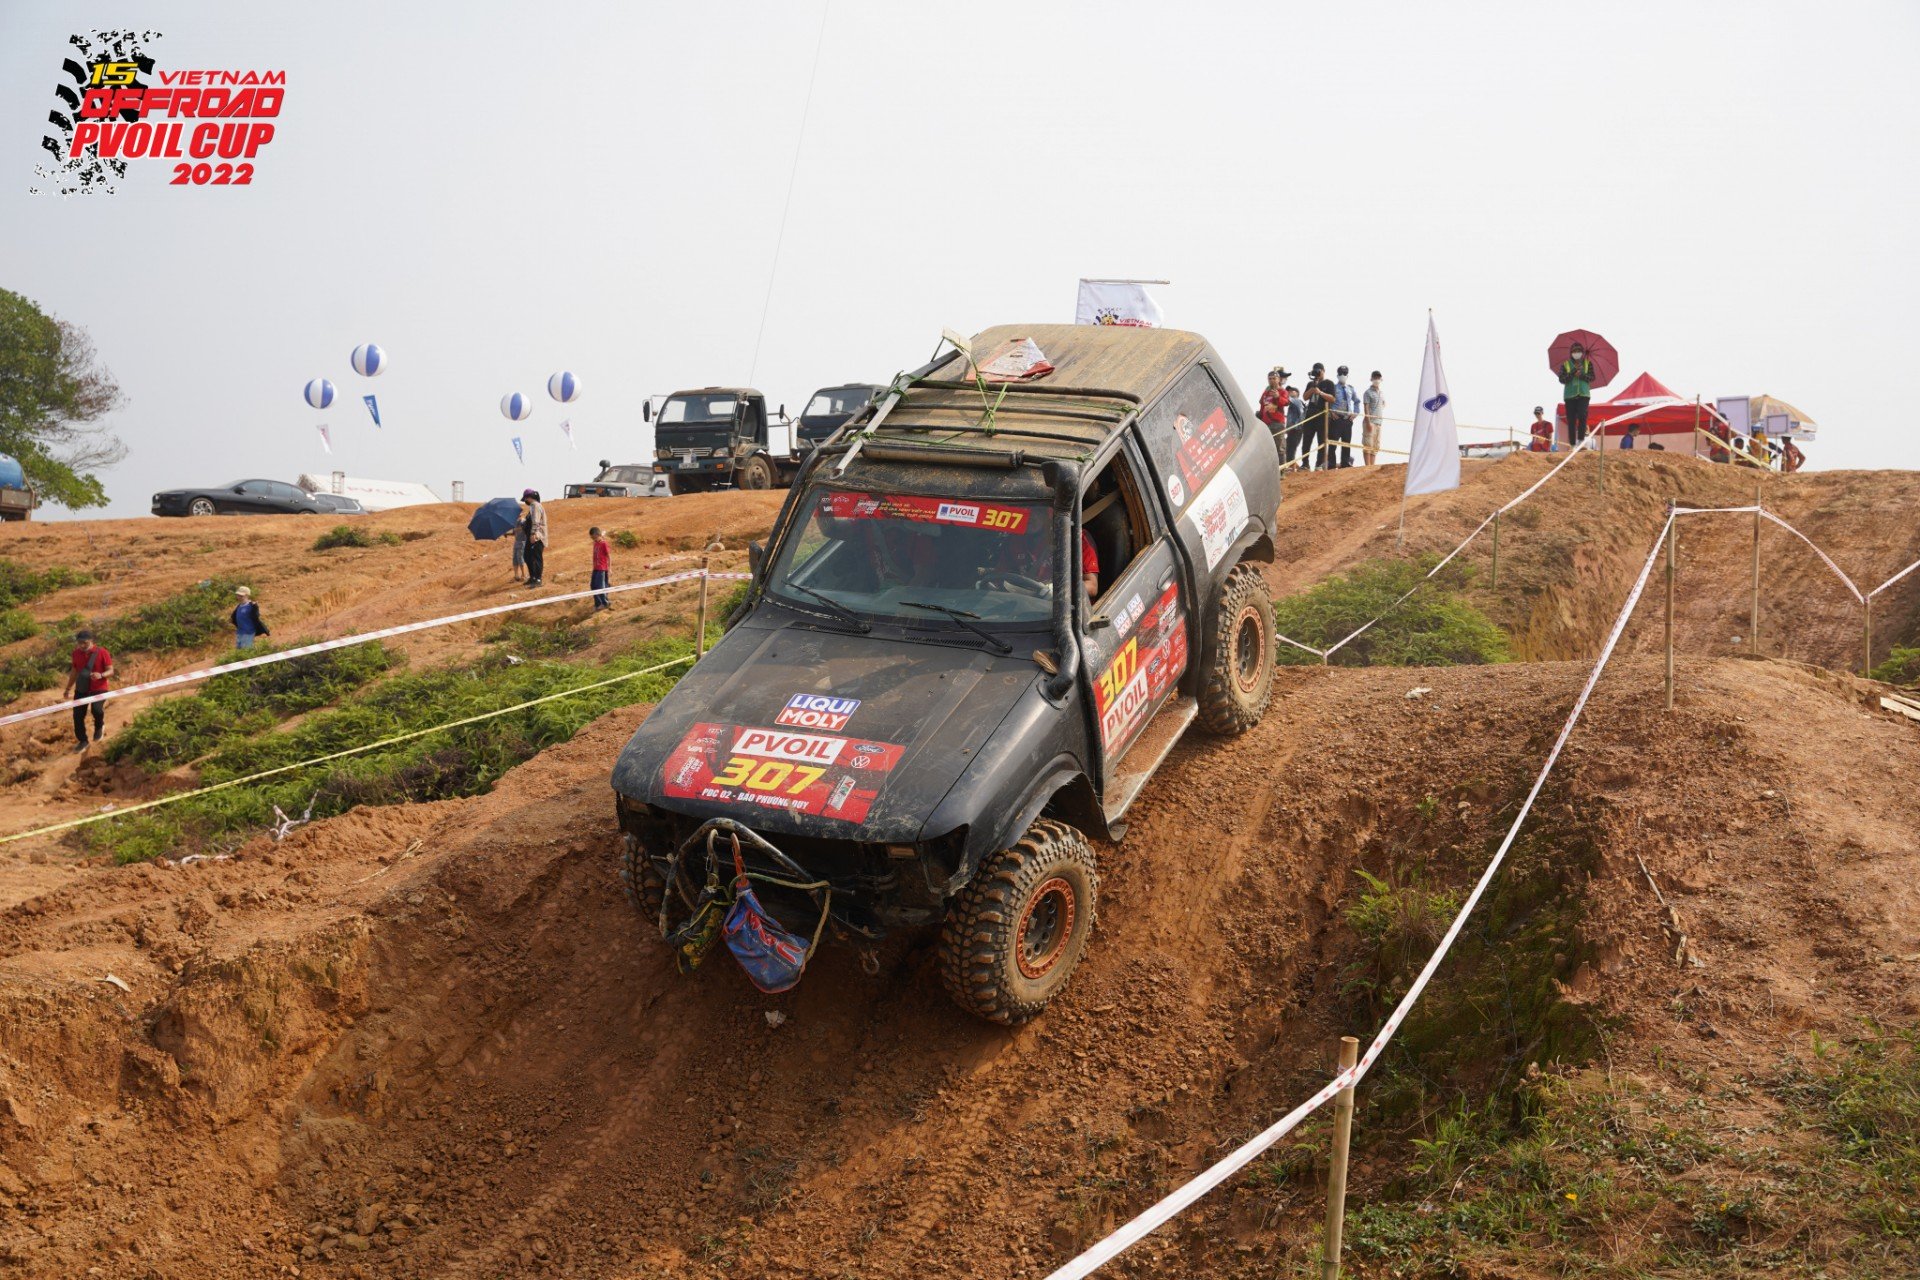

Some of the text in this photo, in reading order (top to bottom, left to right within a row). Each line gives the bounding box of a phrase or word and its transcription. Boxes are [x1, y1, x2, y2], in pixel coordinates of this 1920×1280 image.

[949, 506, 975, 517] PVOIL
[982, 508, 1024, 529] 307
[1100, 636, 1137, 713] 307
[792, 693, 856, 713] LIQUI
[1106, 677, 1146, 738] PVOIL
[779, 709, 845, 729] MOLY
[742, 732, 832, 760] PVOIL
[711, 757, 827, 795] 307
[702, 788, 719, 799] PDC
[720, 790, 732, 800] 02
